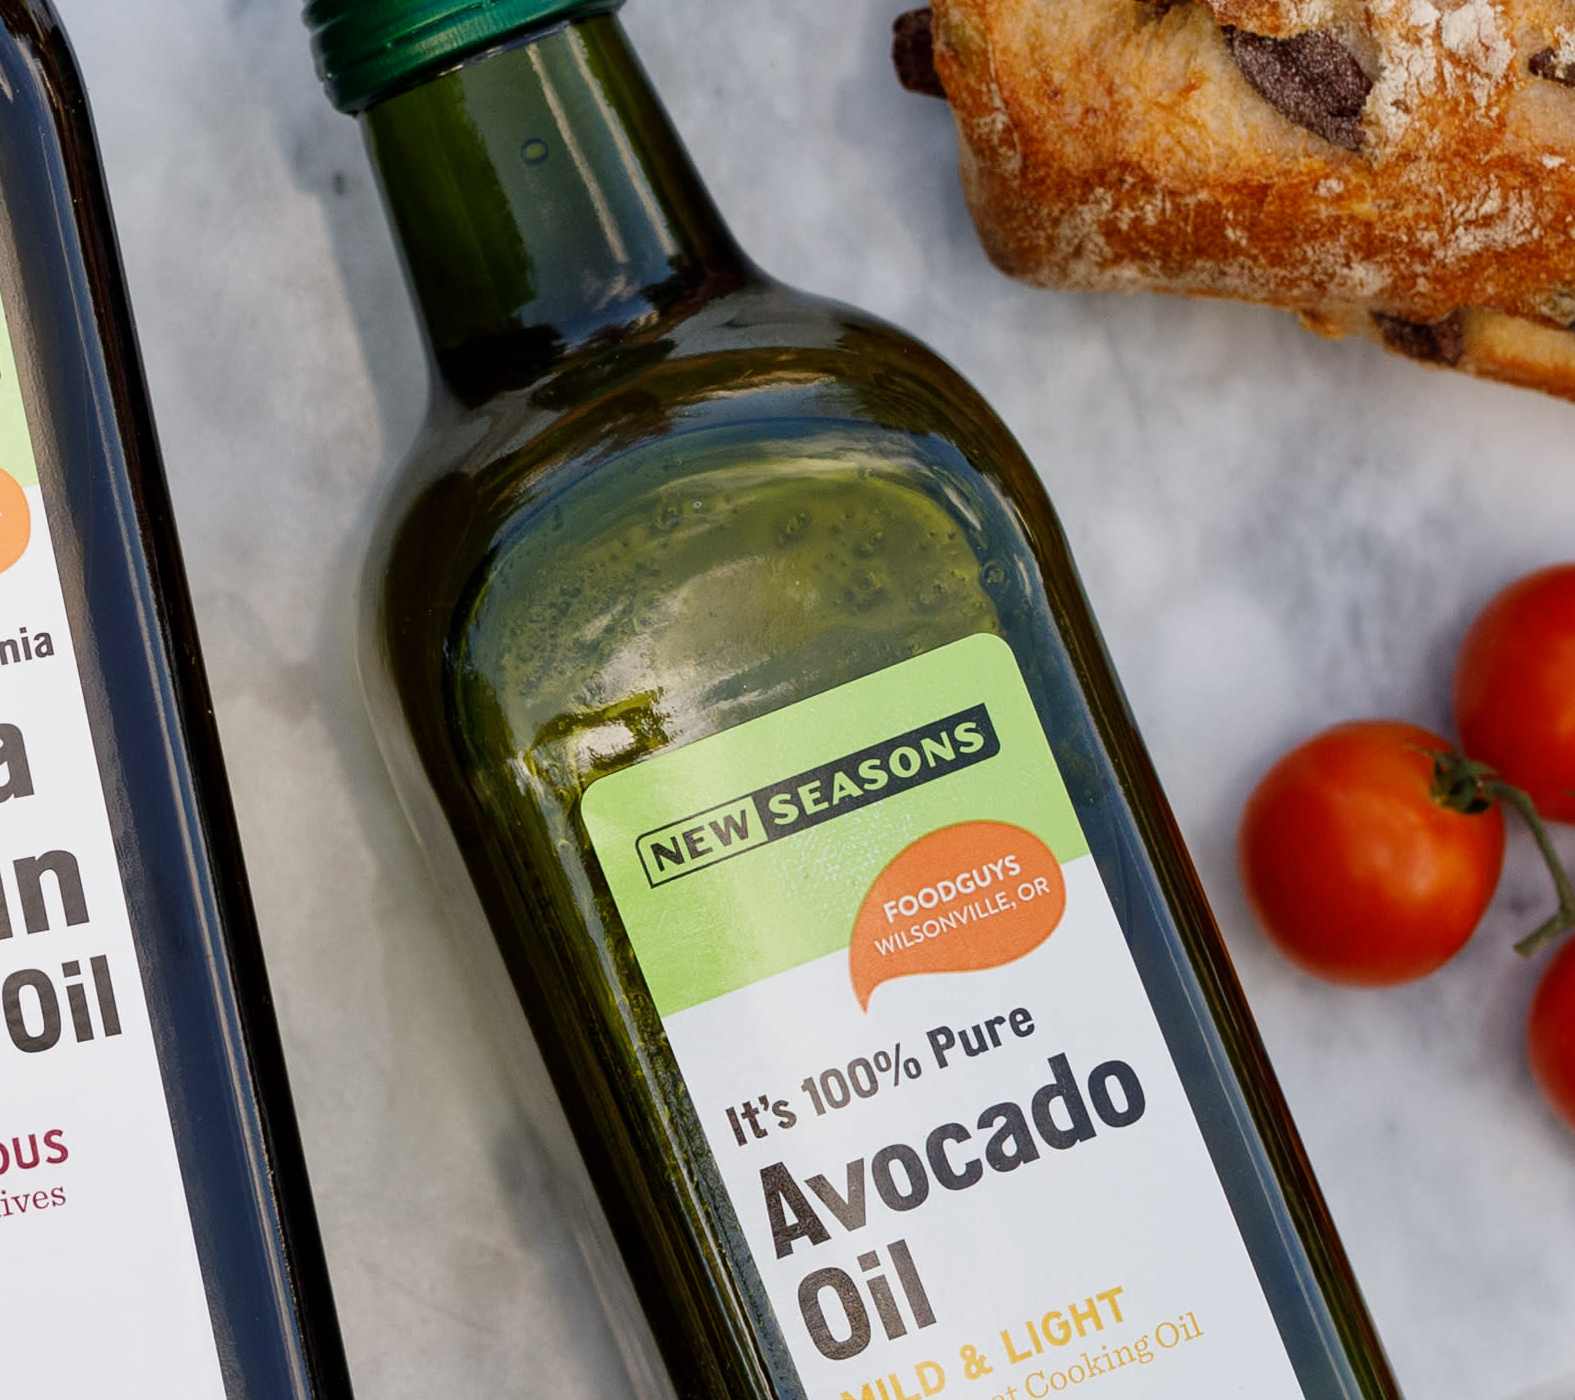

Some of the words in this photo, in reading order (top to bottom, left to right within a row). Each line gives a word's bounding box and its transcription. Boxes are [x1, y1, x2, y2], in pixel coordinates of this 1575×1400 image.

[649, 807, 750, 871] NEW
[767, 719, 985, 826] SEASONS
[874, 891, 1017, 956] WILSONVILLE,
[1017, 877, 1050, 901] OR
[883, 855, 1020, 923] FOODGUYS
[1, 955, 122, 1054] Oil
[725, 1094, 796, 1147] It's
[800, 1043, 921, 1117] 100%
[926, 1005, 1036, 1069] Pure
[759, 1052, 1146, 1259] Avocado
[797, 1239, 938, 1361] Oil
[959, 1344, 993, 1380] &
[1000, 1286, 1125, 1364] LIGHT
[1025, 1334, 1154, 1399] Cooking
[1155, 1311, 1204, 1349] Oil
